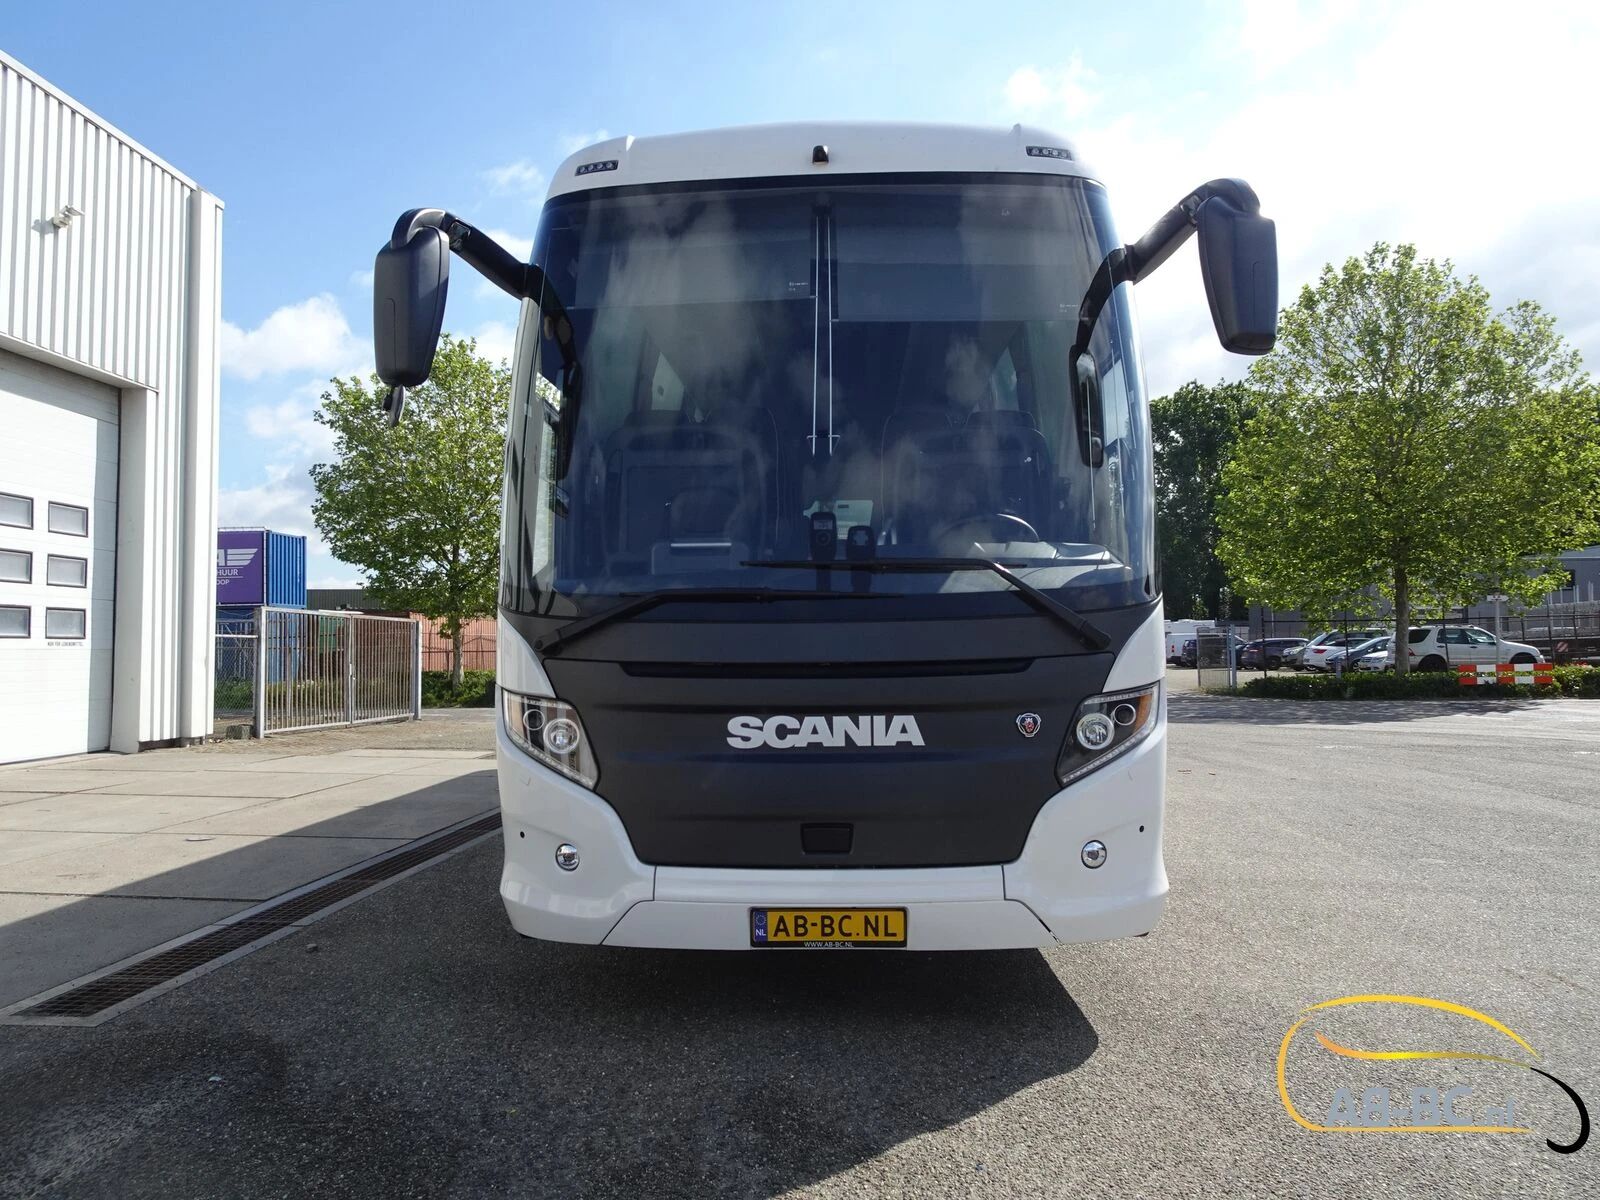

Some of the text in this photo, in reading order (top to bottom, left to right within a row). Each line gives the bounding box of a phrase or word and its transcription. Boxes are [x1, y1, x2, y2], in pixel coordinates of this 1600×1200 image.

[727, 715, 926, 749] SCANIA
[755, 929, 767, 937] NL
[773, 915, 898, 938] AB-BC.NL
